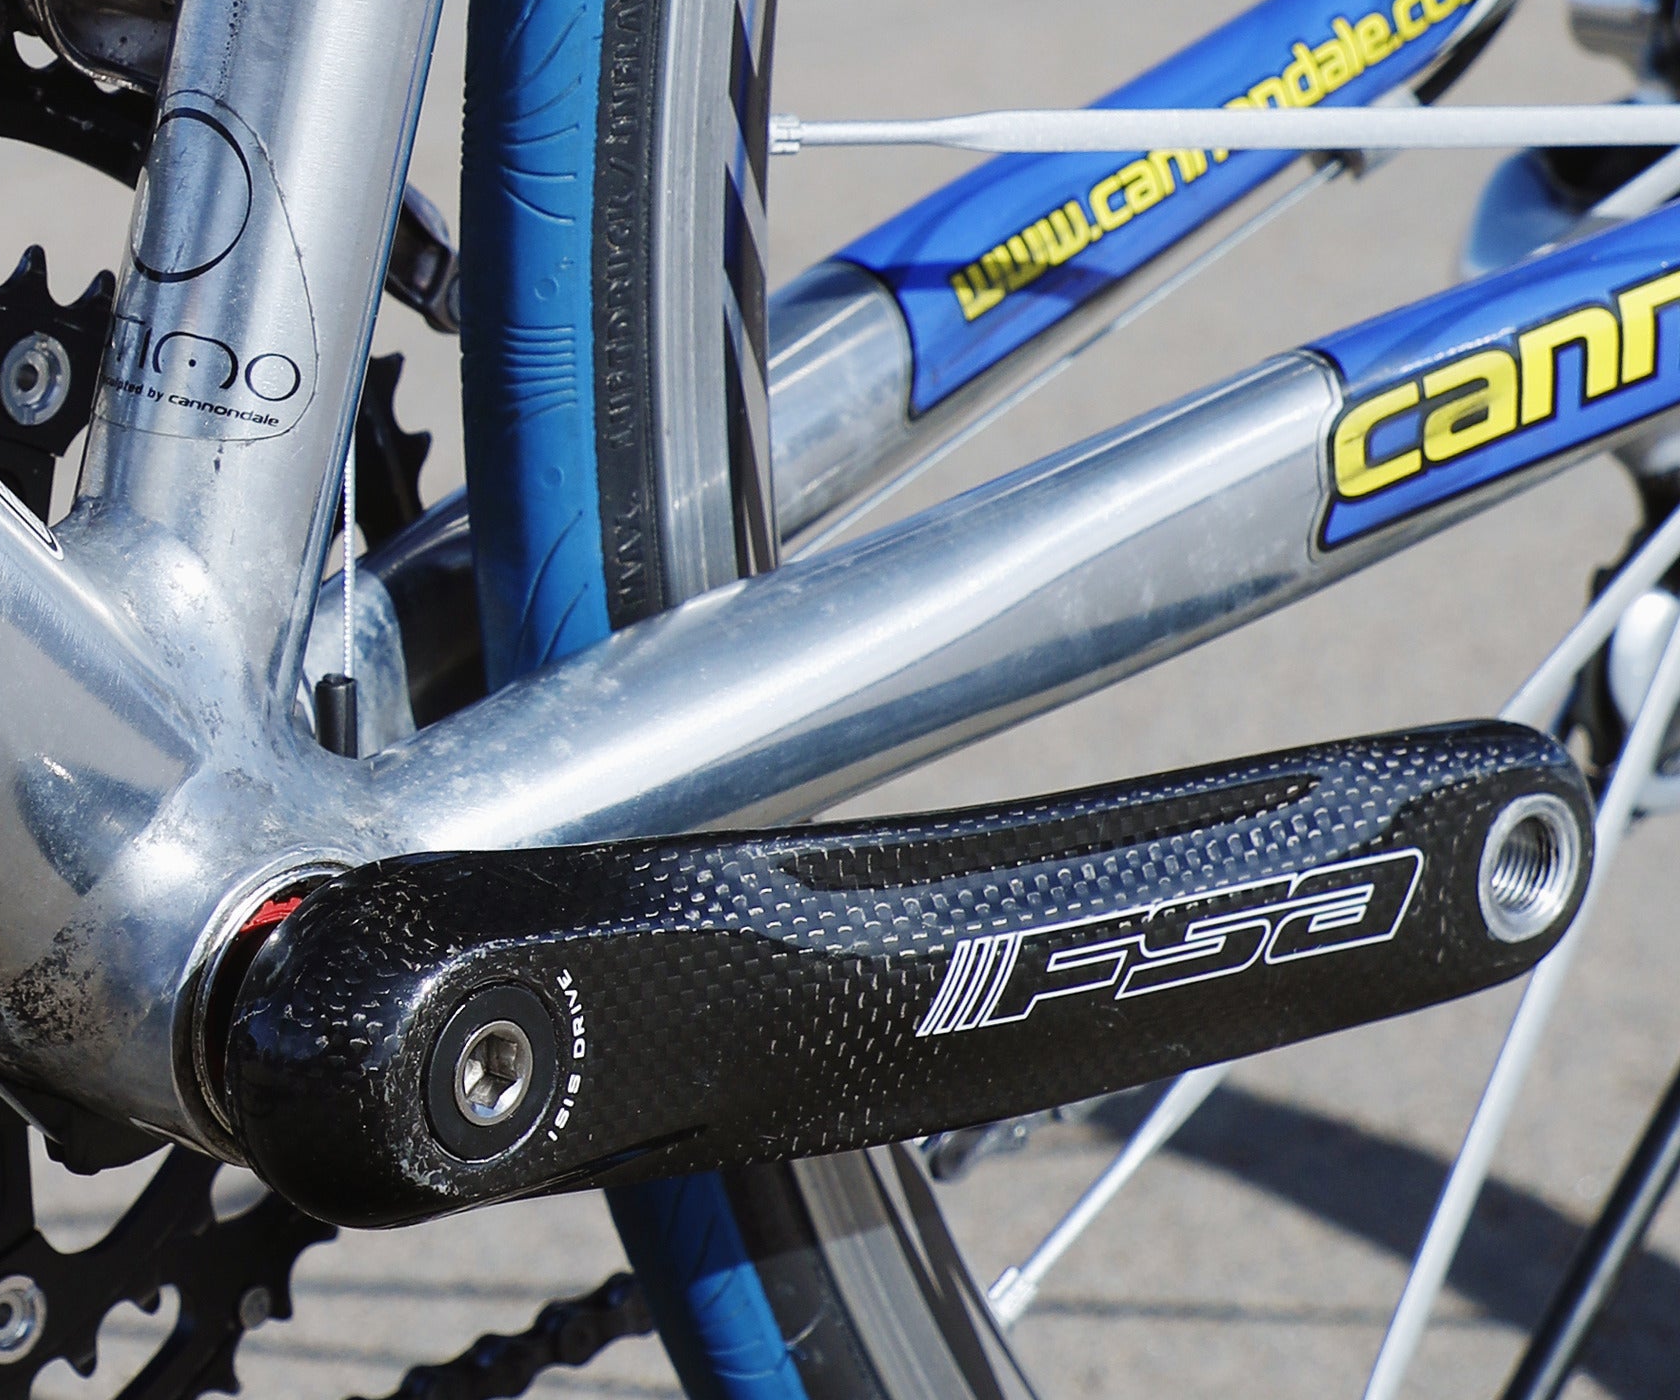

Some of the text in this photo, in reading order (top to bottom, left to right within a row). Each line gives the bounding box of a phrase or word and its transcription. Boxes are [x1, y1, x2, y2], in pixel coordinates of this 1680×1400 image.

[147, 386, 165, 403] by
[168, 393, 280, 428] cannondale
[547, 968, 586, 1142] ISIS DRIVE
